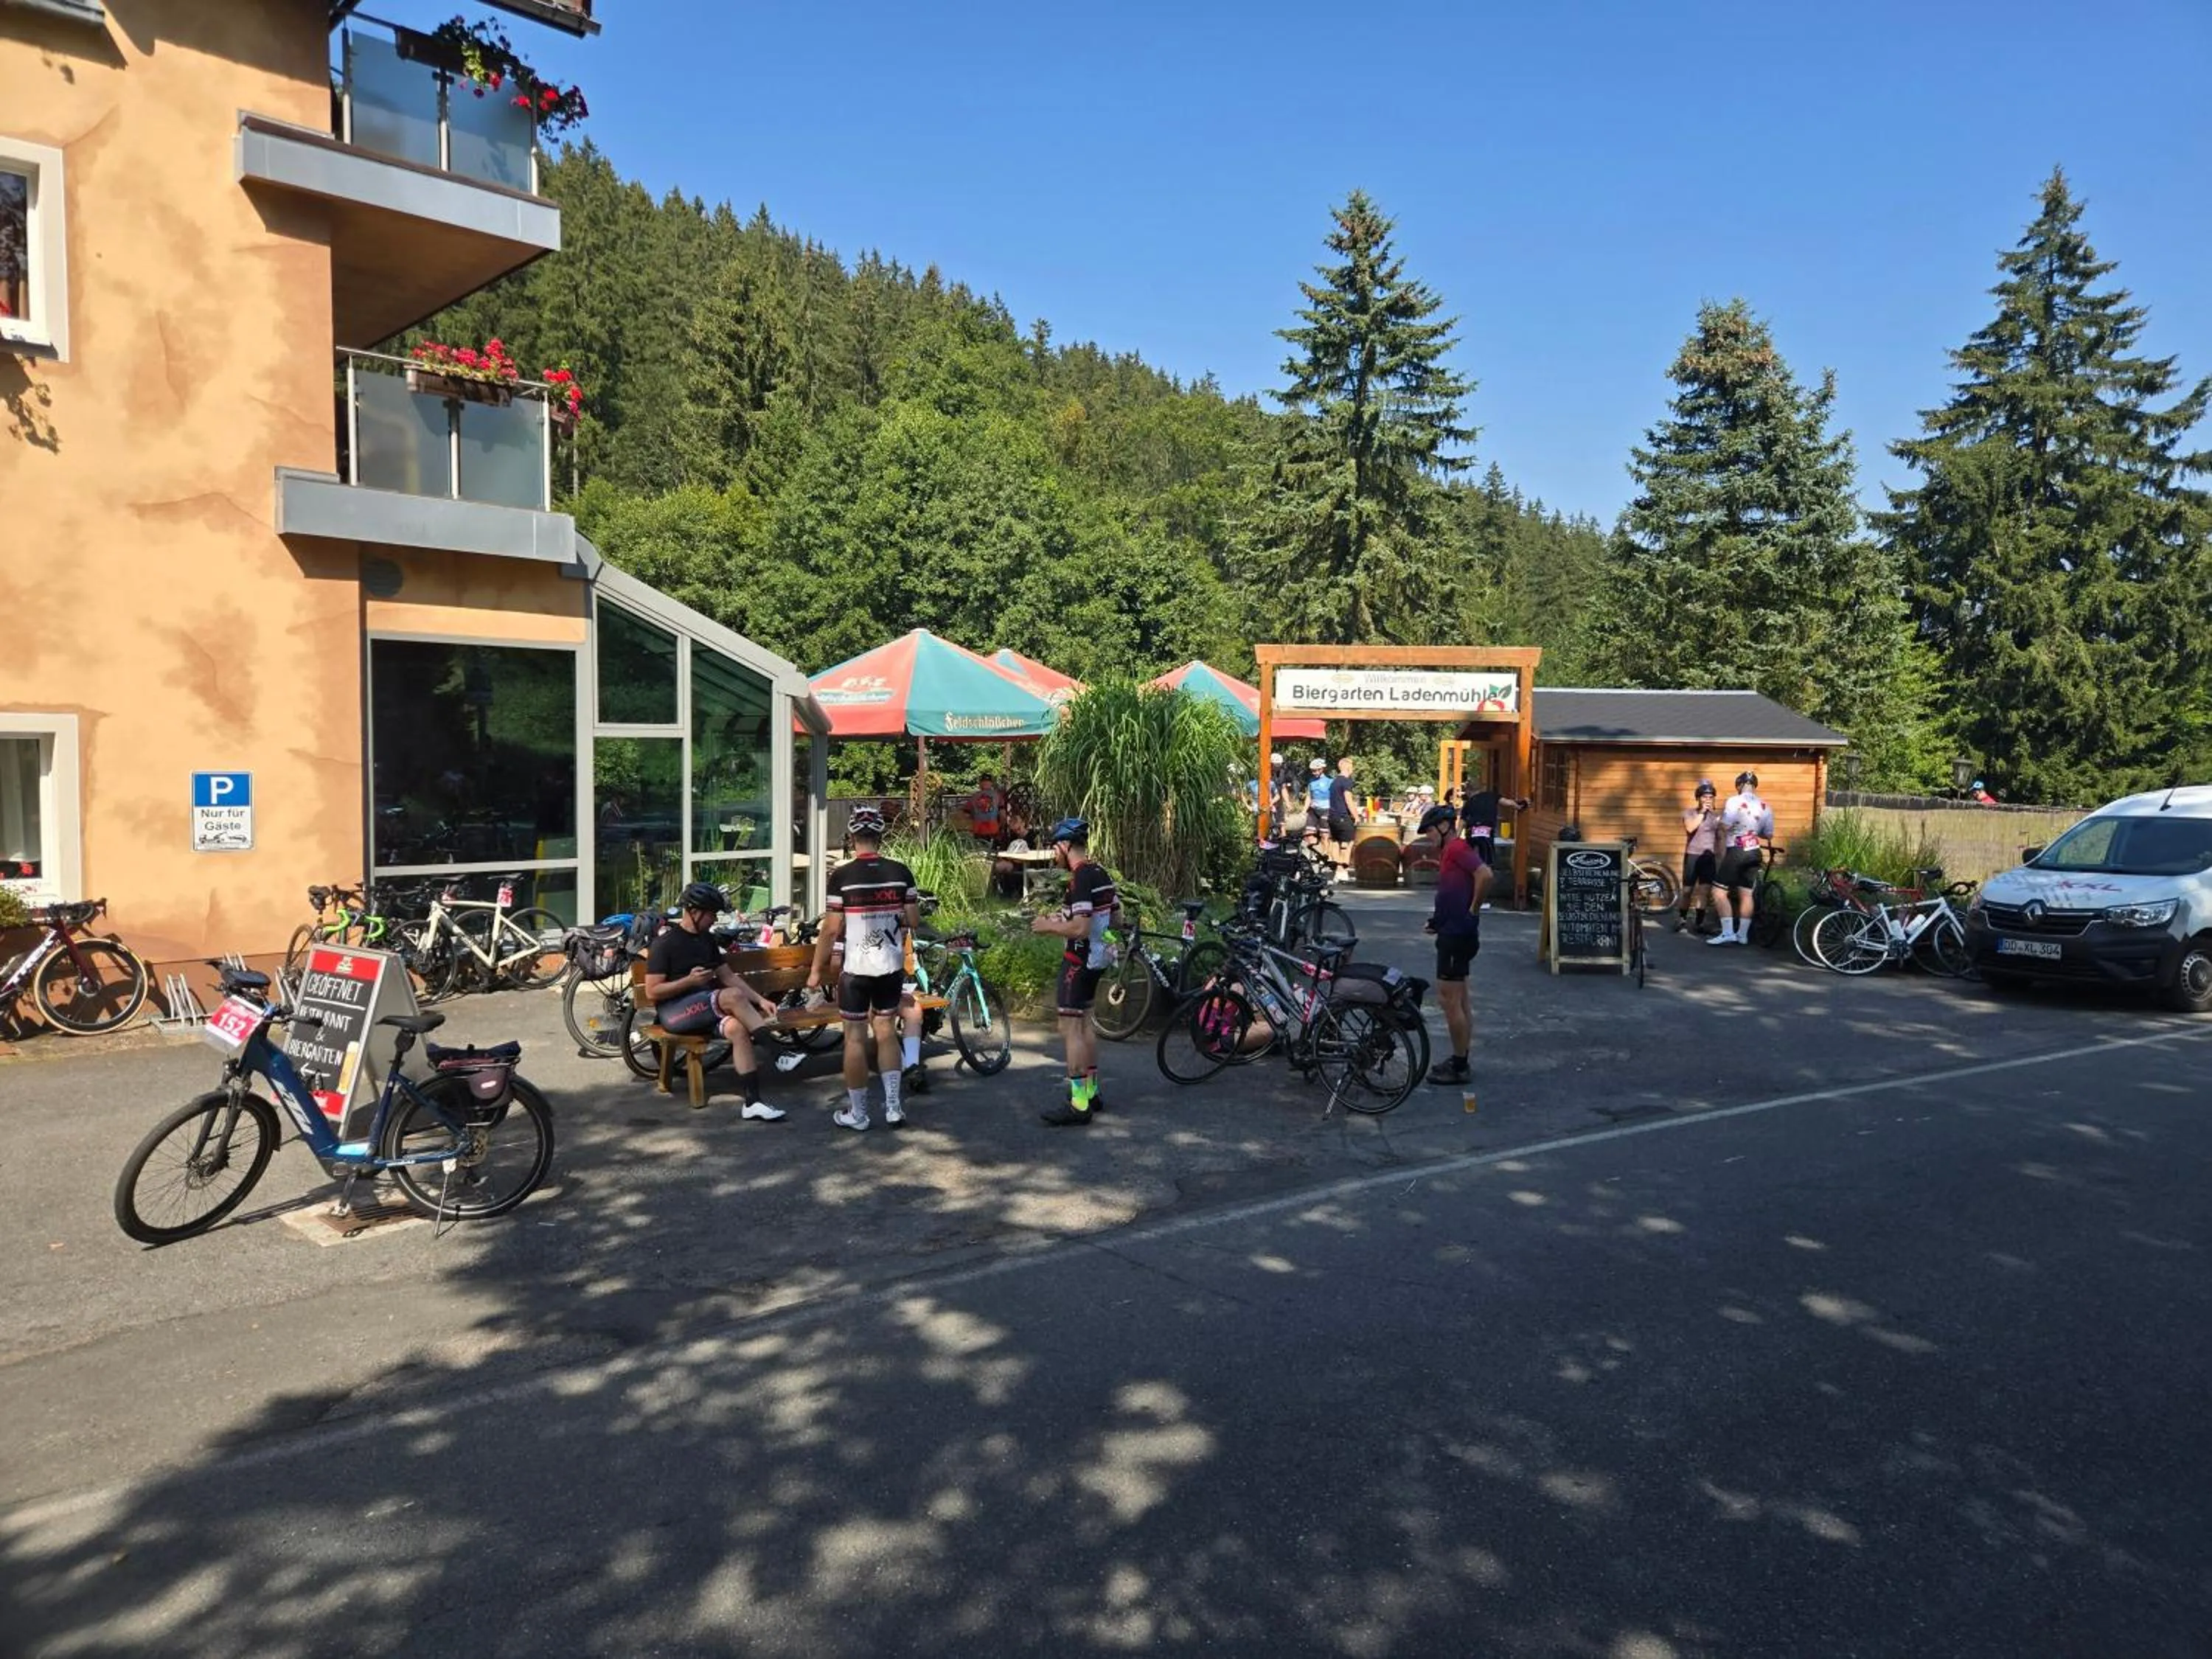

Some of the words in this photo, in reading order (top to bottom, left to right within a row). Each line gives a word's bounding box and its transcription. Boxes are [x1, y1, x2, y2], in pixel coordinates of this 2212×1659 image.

[1292, 685, 1384, 703] Biergarten
[1390, 686, 1498, 703] Ladenmühle
[210, 776, 234, 804] P
[201, 808, 224, 818] Nur
[227, 807, 246, 818] für
[204, 821, 241, 831] Gäste
[306, 973, 364, 1003] GEÖFFNET
[218, 1012, 247, 1037] 152
[288, 1038, 346, 1065] BIERGARTEN
